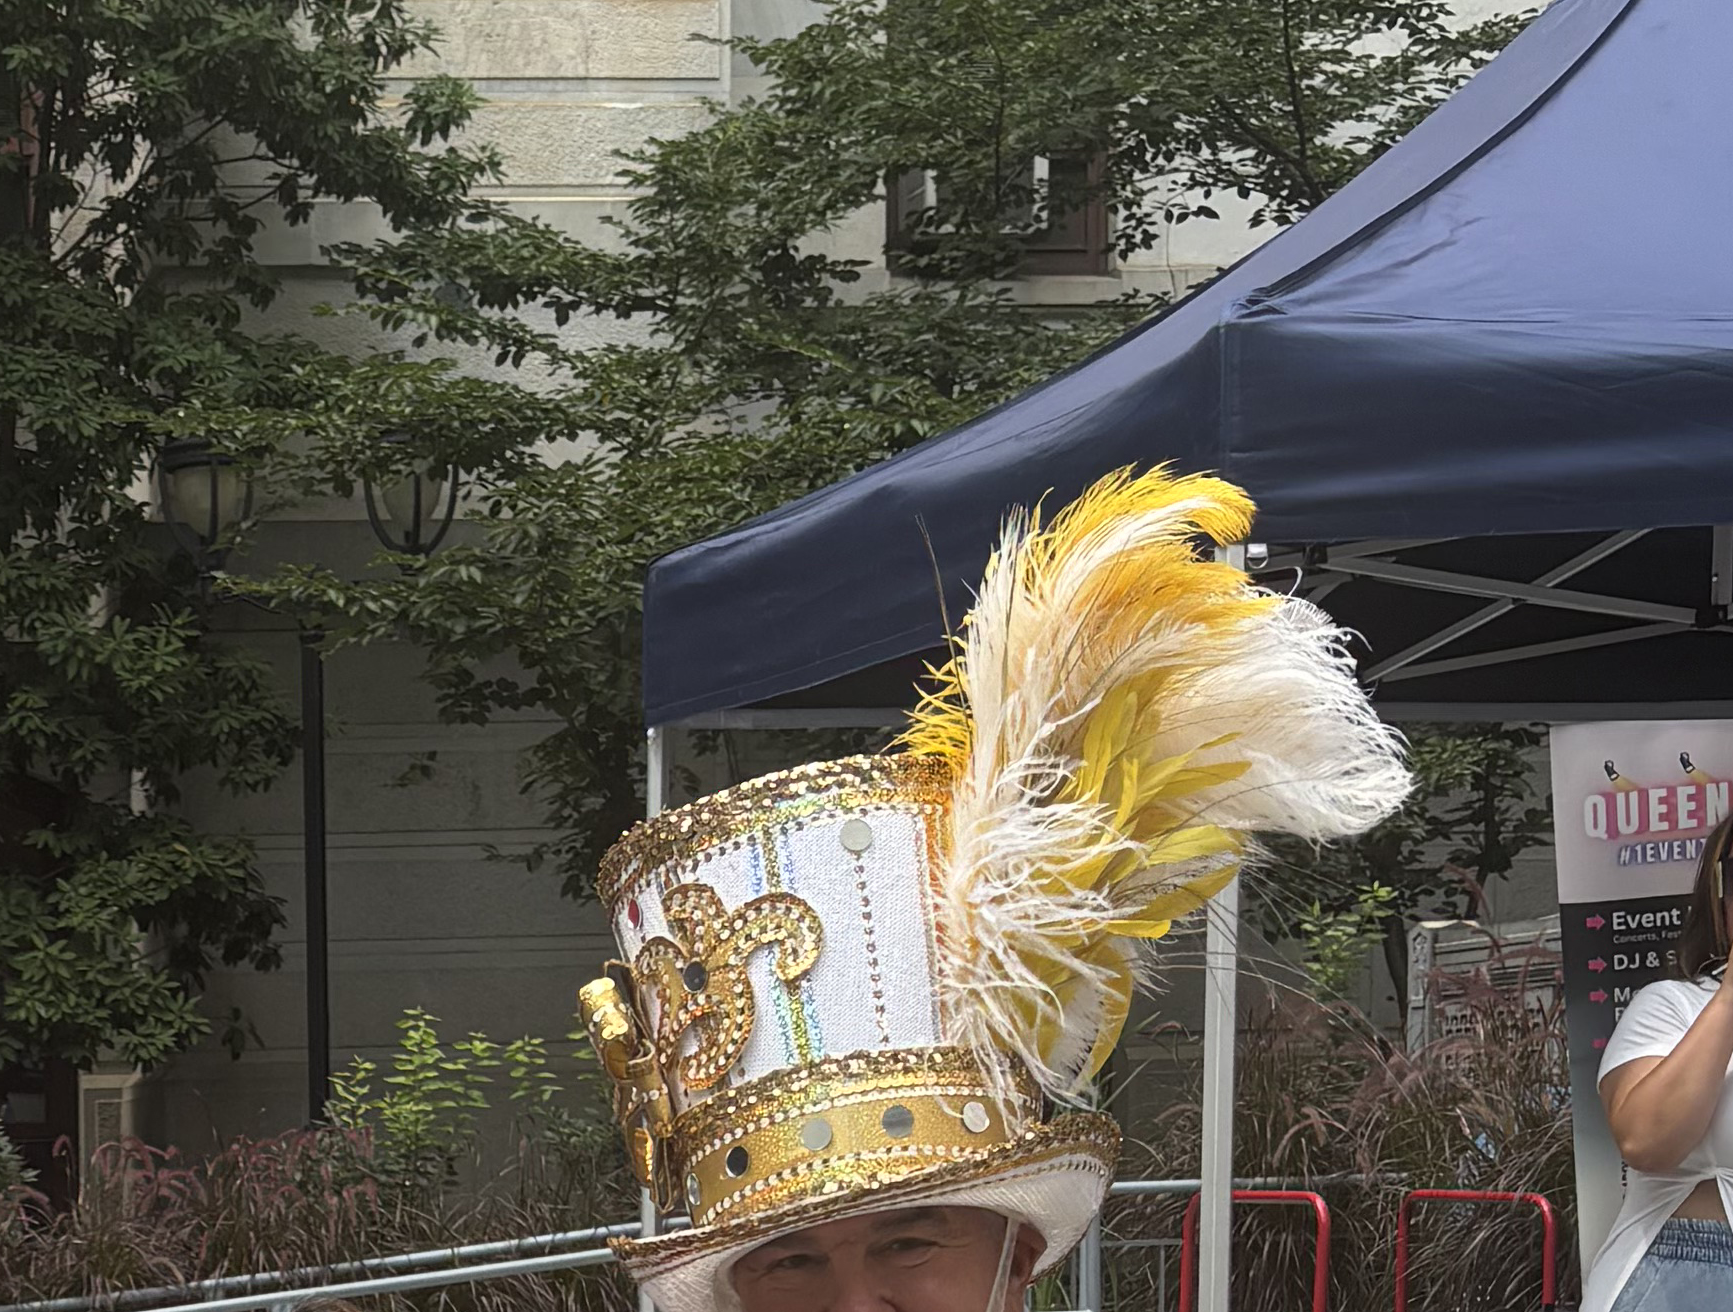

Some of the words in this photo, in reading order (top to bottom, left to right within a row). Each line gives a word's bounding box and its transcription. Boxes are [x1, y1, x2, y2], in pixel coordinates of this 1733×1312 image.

[1584, 782, 1729, 840] QUEEN
[1612, 908, 1681, 931] Event
[1613, 953, 1641, 971] DJ
[1645, 951, 1661, 968] &
